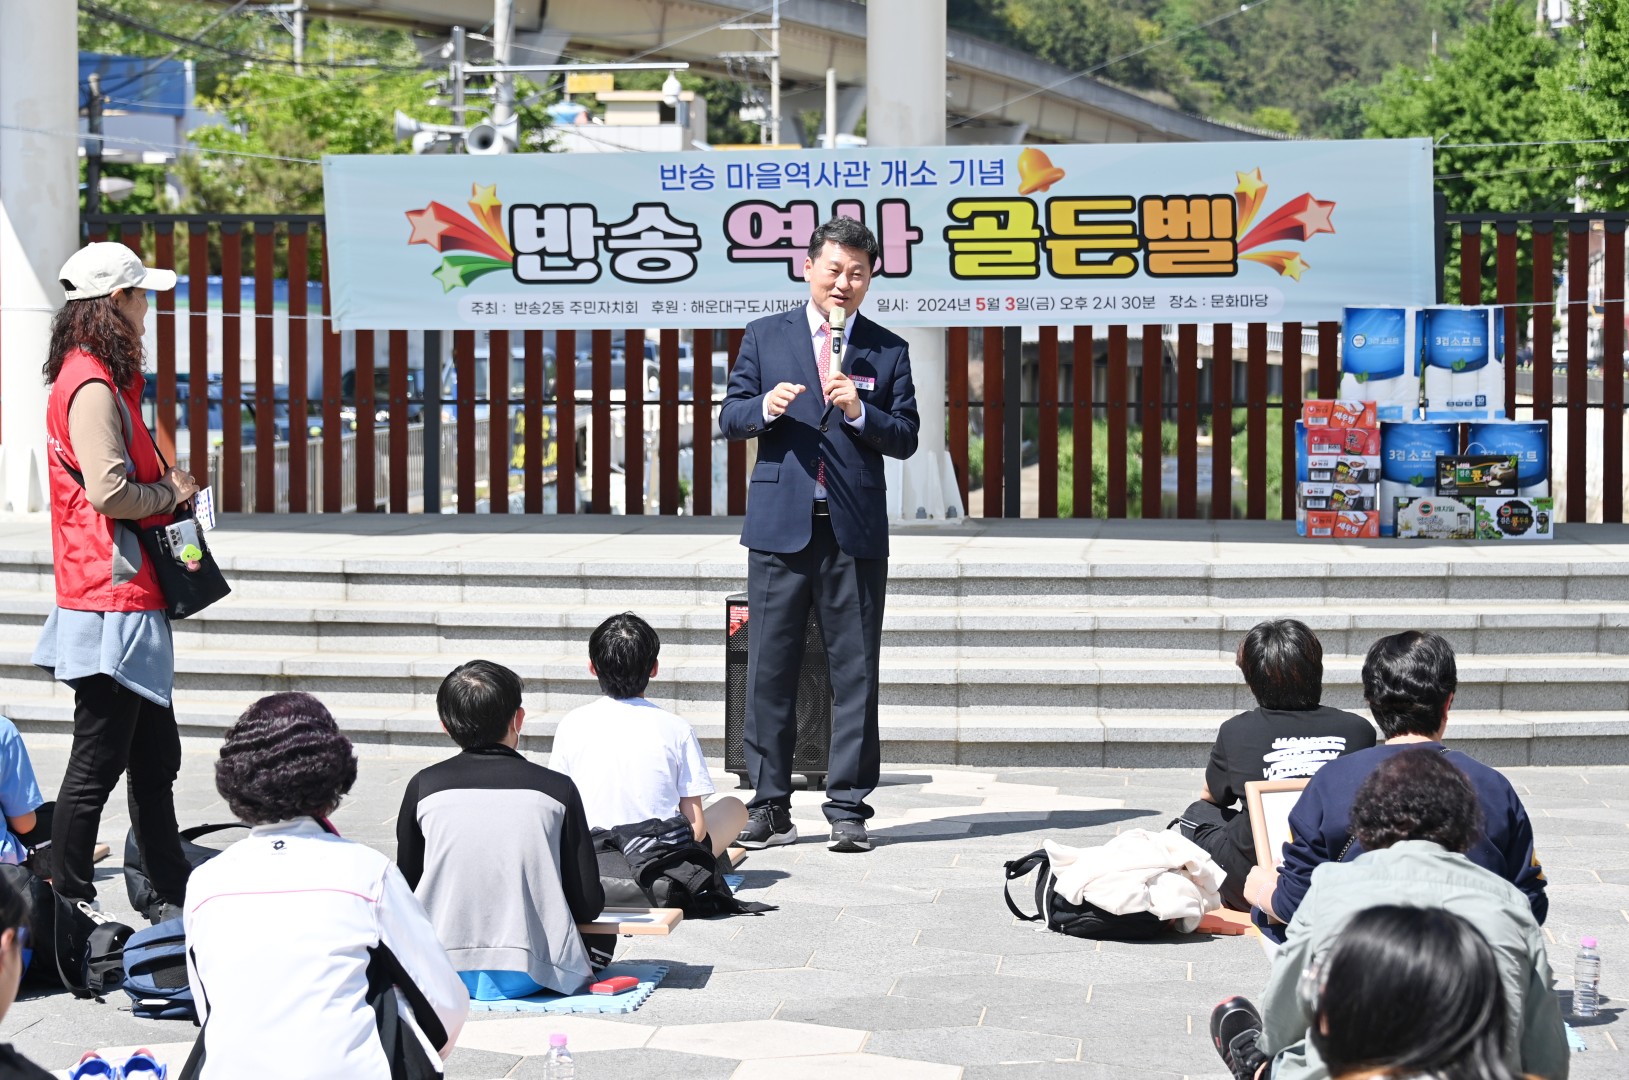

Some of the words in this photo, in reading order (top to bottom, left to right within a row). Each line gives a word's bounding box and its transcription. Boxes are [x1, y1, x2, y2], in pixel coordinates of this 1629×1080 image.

[660, 164, 716, 191] 반송
[727, 161, 871, 190] 마을역사관
[880, 159, 938, 187] 개소
[949, 158, 1005, 187] 기념
[508, 202, 701, 284] 반송
[722, 198, 923, 283] 역사
[943, 194, 1239, 281] 골든벨
[471, 301, 498, 315] 주최
[514, 301, 566, 316] 반송2동
[569, 300, 638, 315] 주민자치회
[651, 300, 679, 314] 후원
[690, 299, 808, 314] 해운대구도시재생
[877, 298, 909, 312] 일시:
[917, 297, 971, 312] 2024년
[975, 297, 1000, 312] 5월
[1005, 296, 1055, 312] 3일(금)
[1060, 296, 1088, 310] 오후
[1093, 296, 1116, 310] 2시
[1121, 296, 1156, 310] 30분
[1169, 295, 1198, 309] 장소
[1210, 294, 1269, 308] 문화마당
[1435, 336, 1482, 347] 3겹소프트
